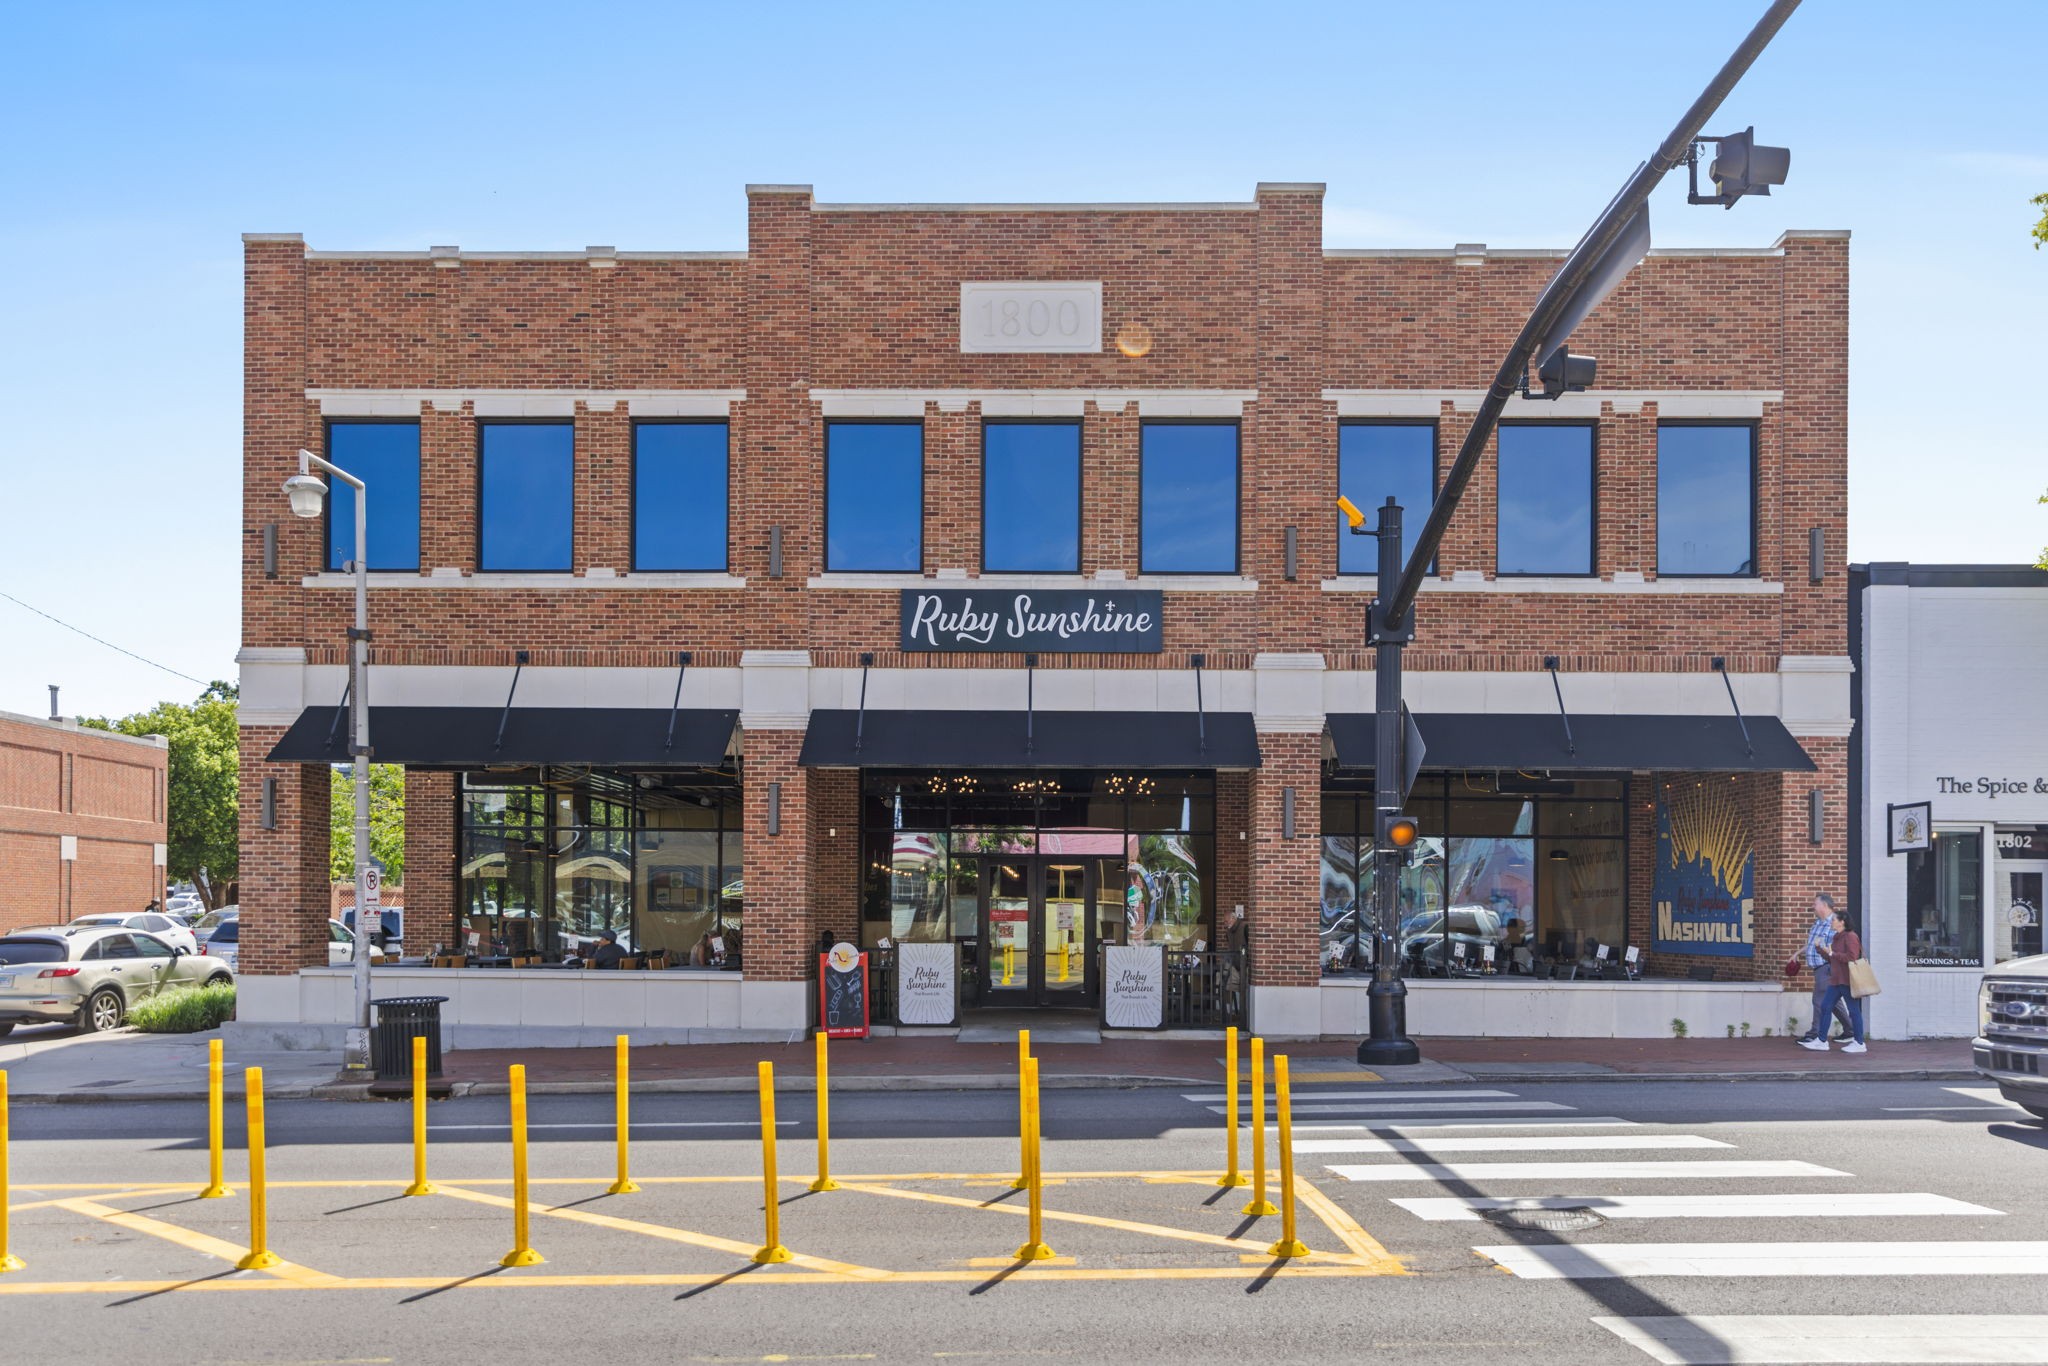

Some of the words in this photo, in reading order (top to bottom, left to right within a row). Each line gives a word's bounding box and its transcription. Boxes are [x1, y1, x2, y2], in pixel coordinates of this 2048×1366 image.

[982, 299, 1080, 337] 1800
[910, 595, 999, 646] Ruby
[1007, 594, 1153, 639] Sunshine
[1936, 776, 1973, 793] The
[1977, 777, 2028, 799] Spice
[1998, 835, 2032, 848] 1802
[1657, 898, 1753, 943] NASHVILLE
[1907, 956, 1954, 965] SEASONINGS
[914, 966, 940, 981] Ruby
[1122, 969, 1147, 984] Ruby
[906, 978, 946, 990] Sunshine
[1113, 981, 1154, 993] Sunshine
